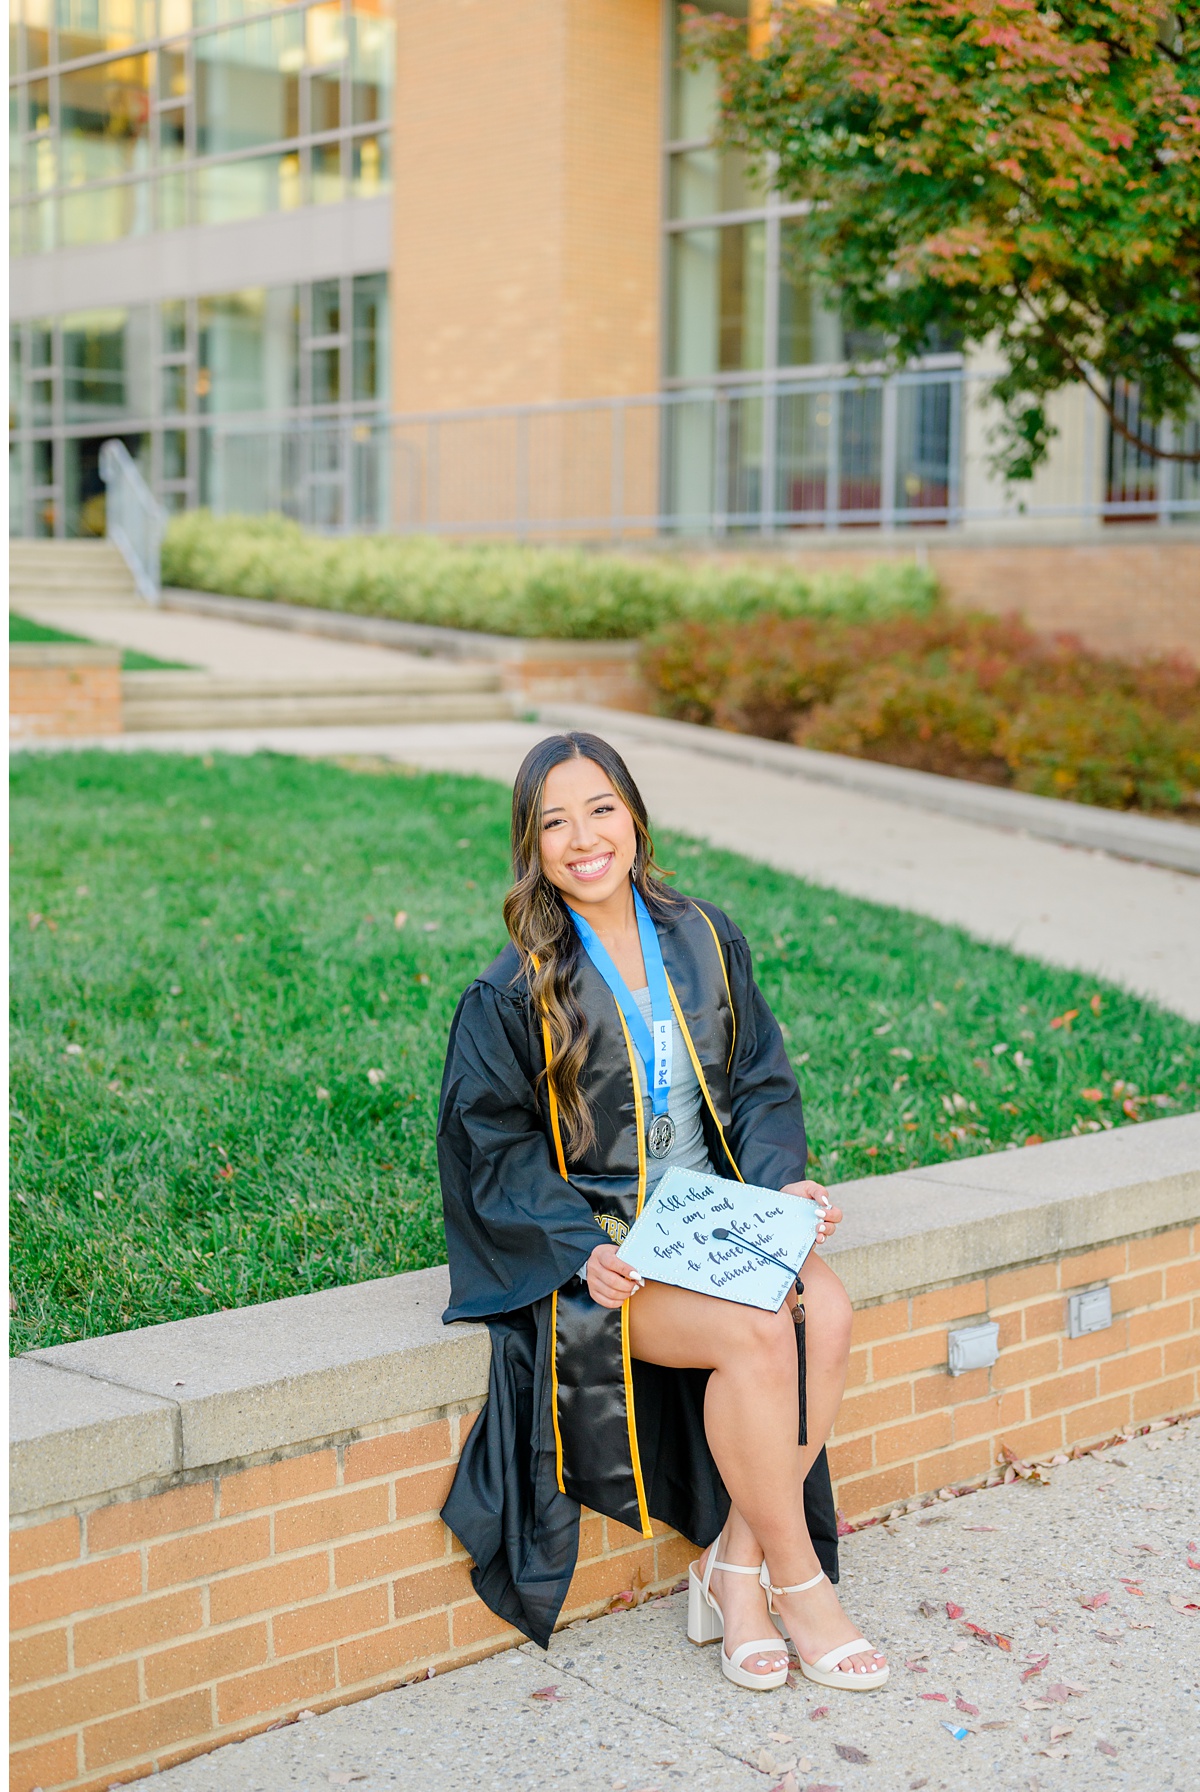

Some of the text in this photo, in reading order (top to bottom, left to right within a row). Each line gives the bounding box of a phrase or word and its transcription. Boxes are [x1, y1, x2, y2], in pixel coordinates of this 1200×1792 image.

[656, 1186, 714, 1214] All that
[656, 1197, 734, 1236] I am and
[653, 1240, 685, 1259] hope
[693, 1231, 709, 1245] to
[753, 1213, 765, 1224] I
[687, 1233, 774, 1272] to those who
[710, 1260, 757, 1288] believed
[755, 1257, 771, 1266] in
[770, 1247, 788, 1258] me
